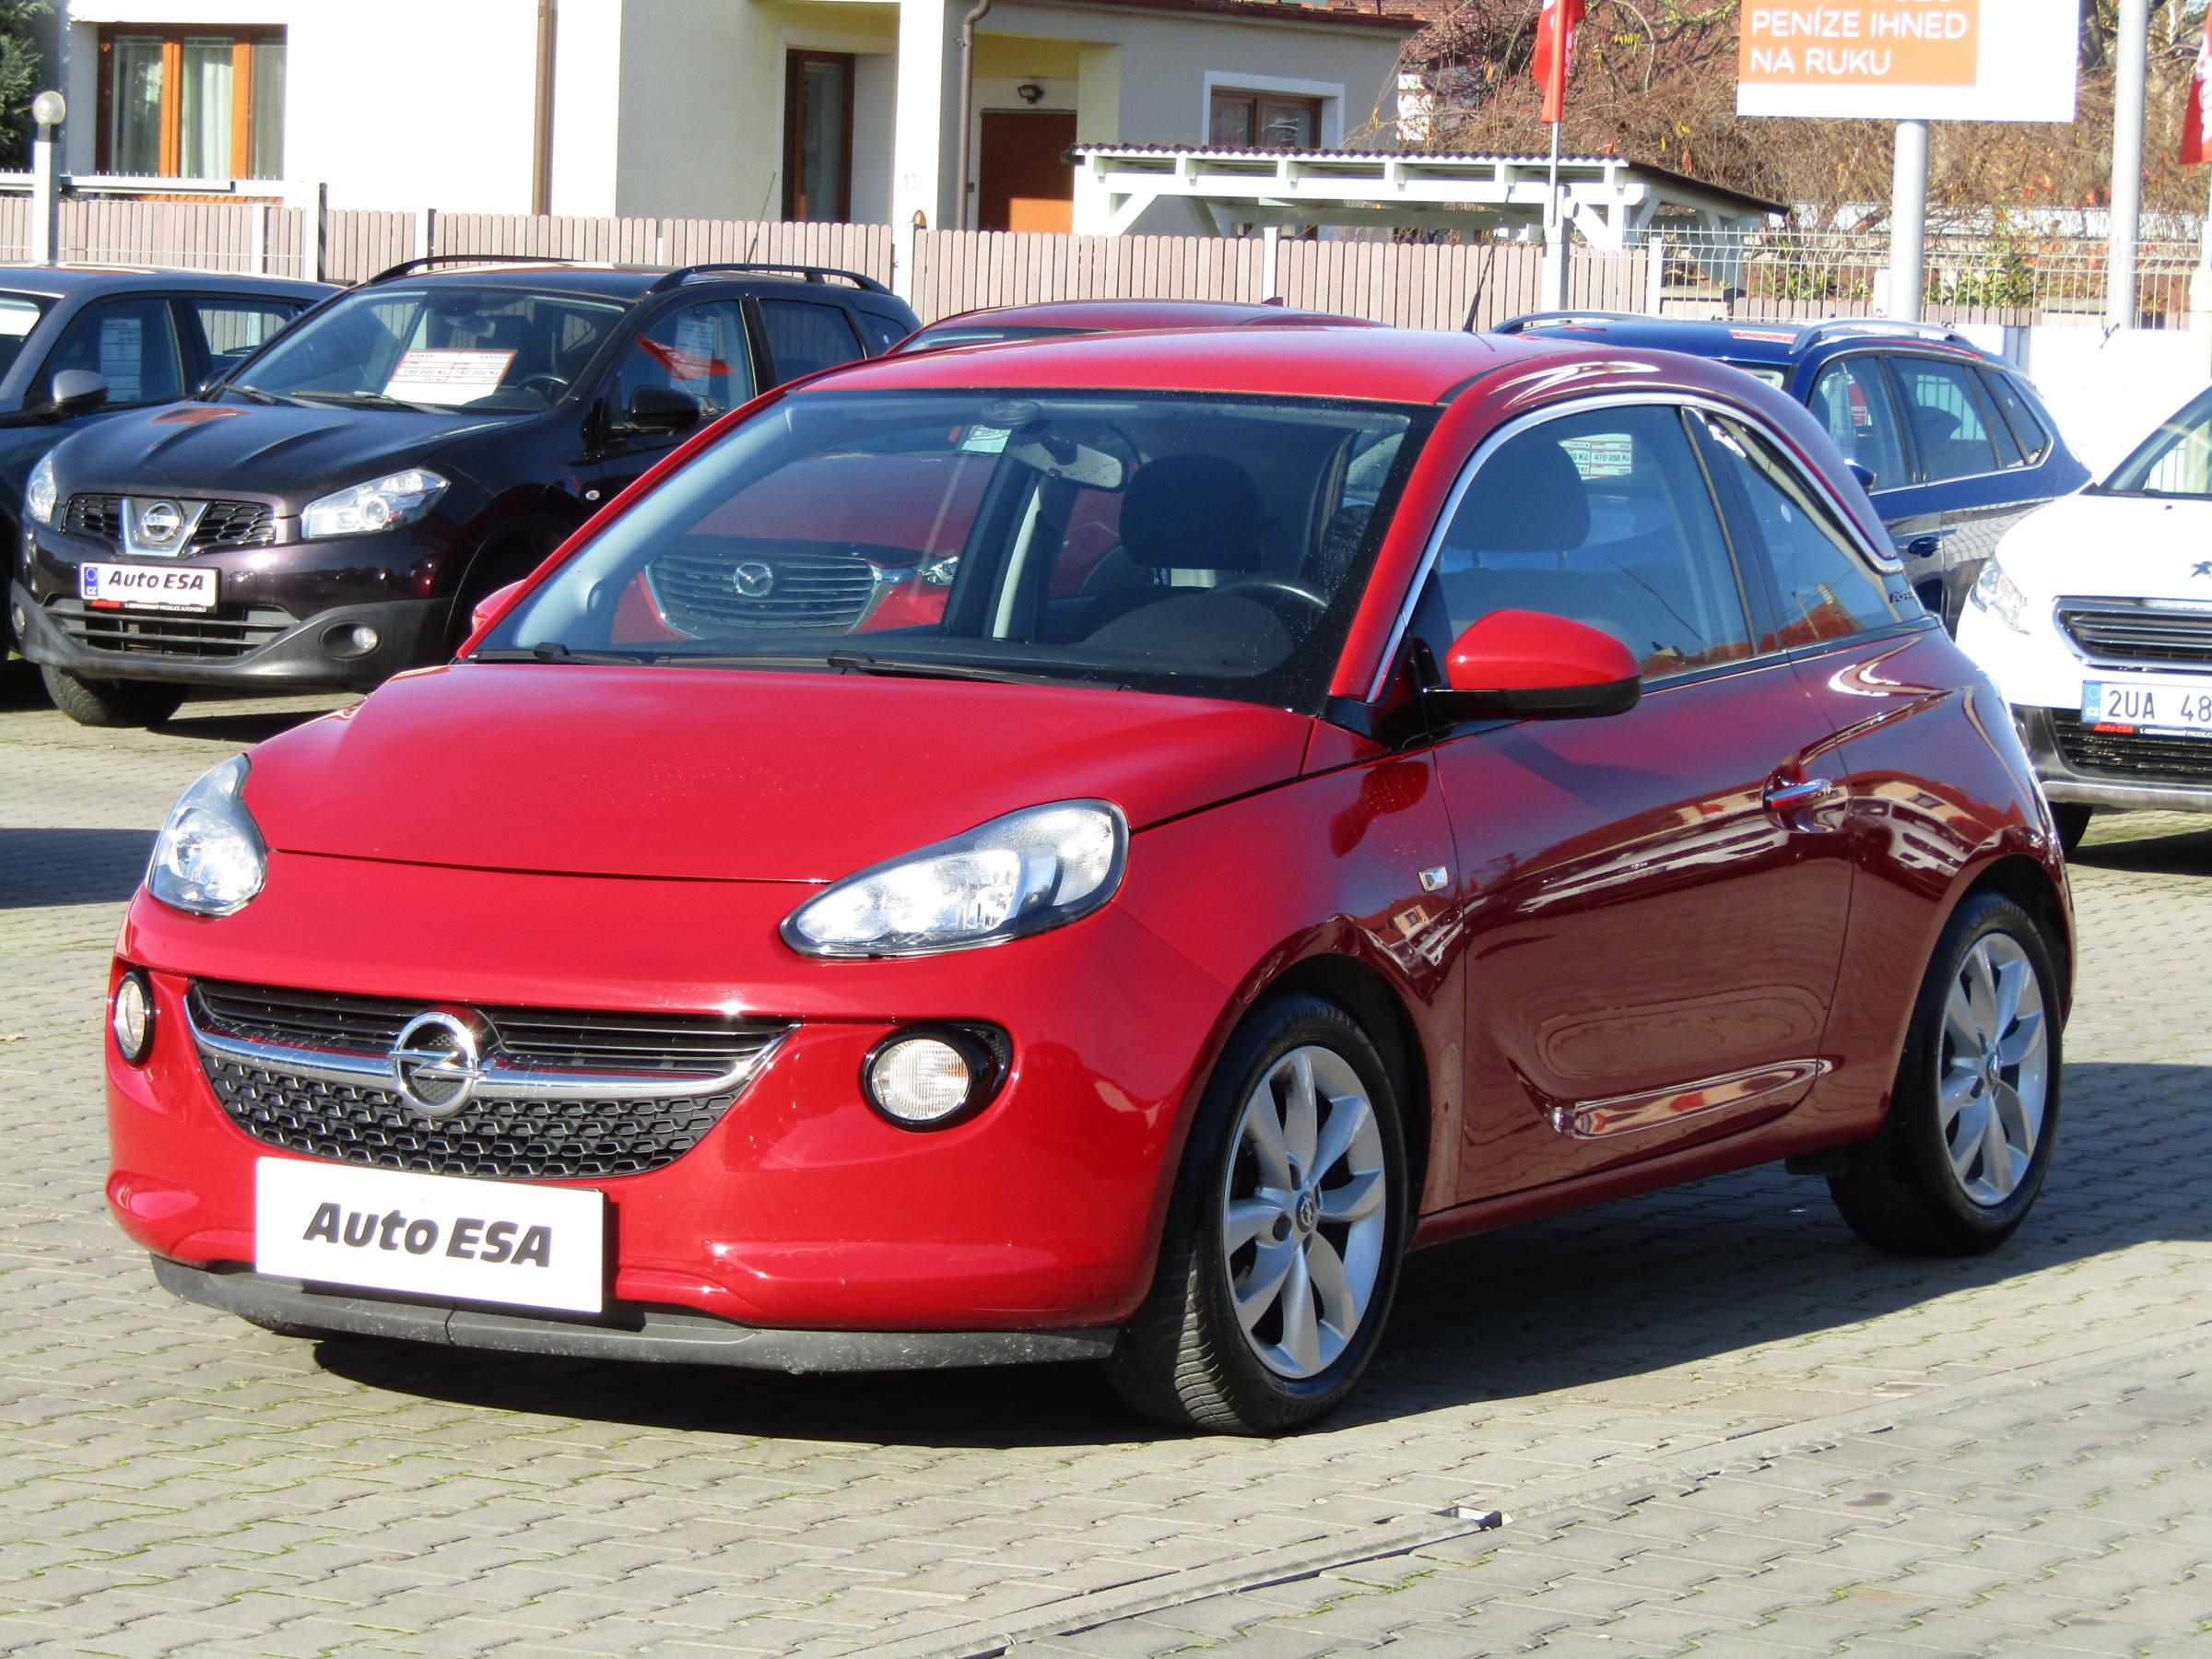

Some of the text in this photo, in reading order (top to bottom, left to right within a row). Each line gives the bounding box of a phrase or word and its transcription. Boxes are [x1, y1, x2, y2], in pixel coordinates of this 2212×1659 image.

[1751, 6, 1967, 39] PENÍZE IHNED
[1750, 48, 1891, 76] NA RUKU
[87, 587, 97, 595] CZ
[108, 570, 204, 591] Auto ESA
[2108, 690, 2155, 720] 2UA
[302, 1202, 552, 1268] Auto ESA
